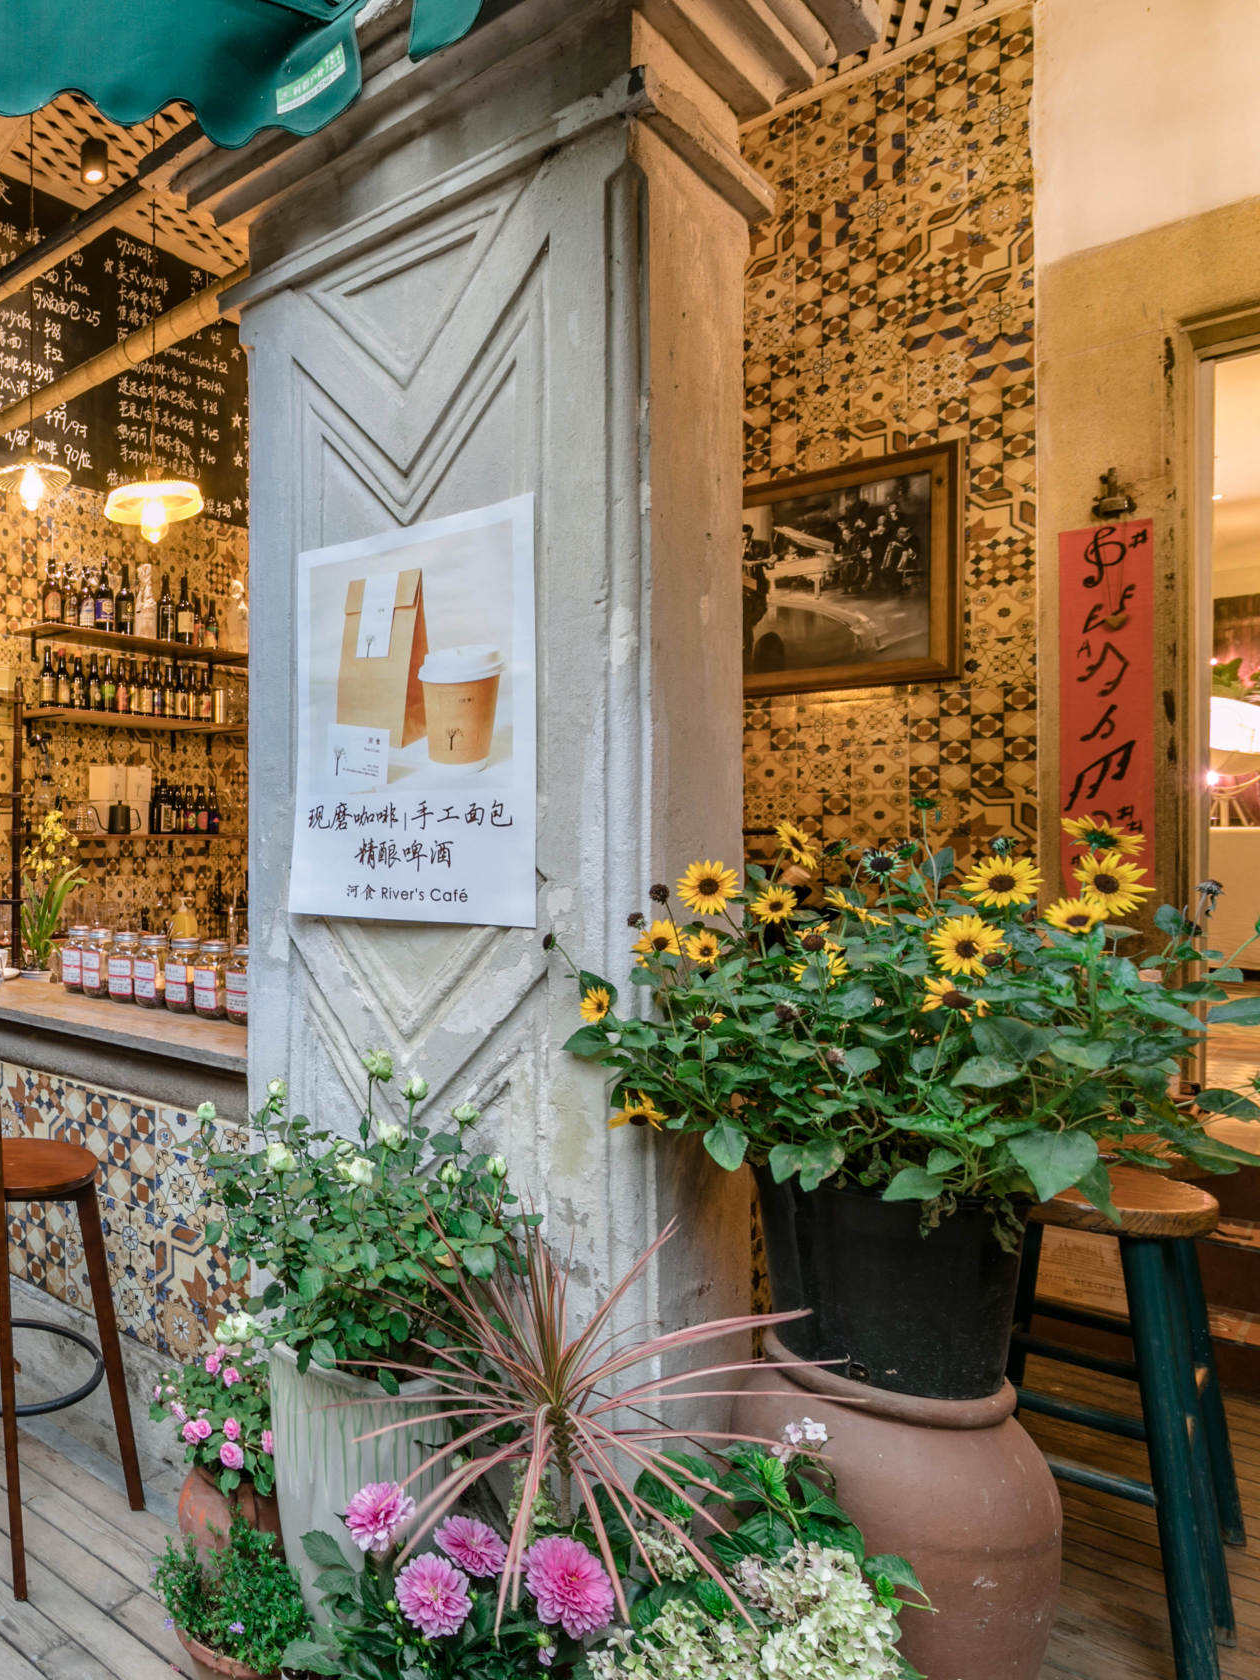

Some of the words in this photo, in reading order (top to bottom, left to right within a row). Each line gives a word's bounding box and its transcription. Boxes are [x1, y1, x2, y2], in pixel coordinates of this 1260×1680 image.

[116, 305, 158, 327] 焦糖拿
[352, 839, 456, 873] 精酿啤酒
[345, 883, 377, 901] 河食
[380, 885, 426, 902] River's
[429, 887, 469, 903] Café
